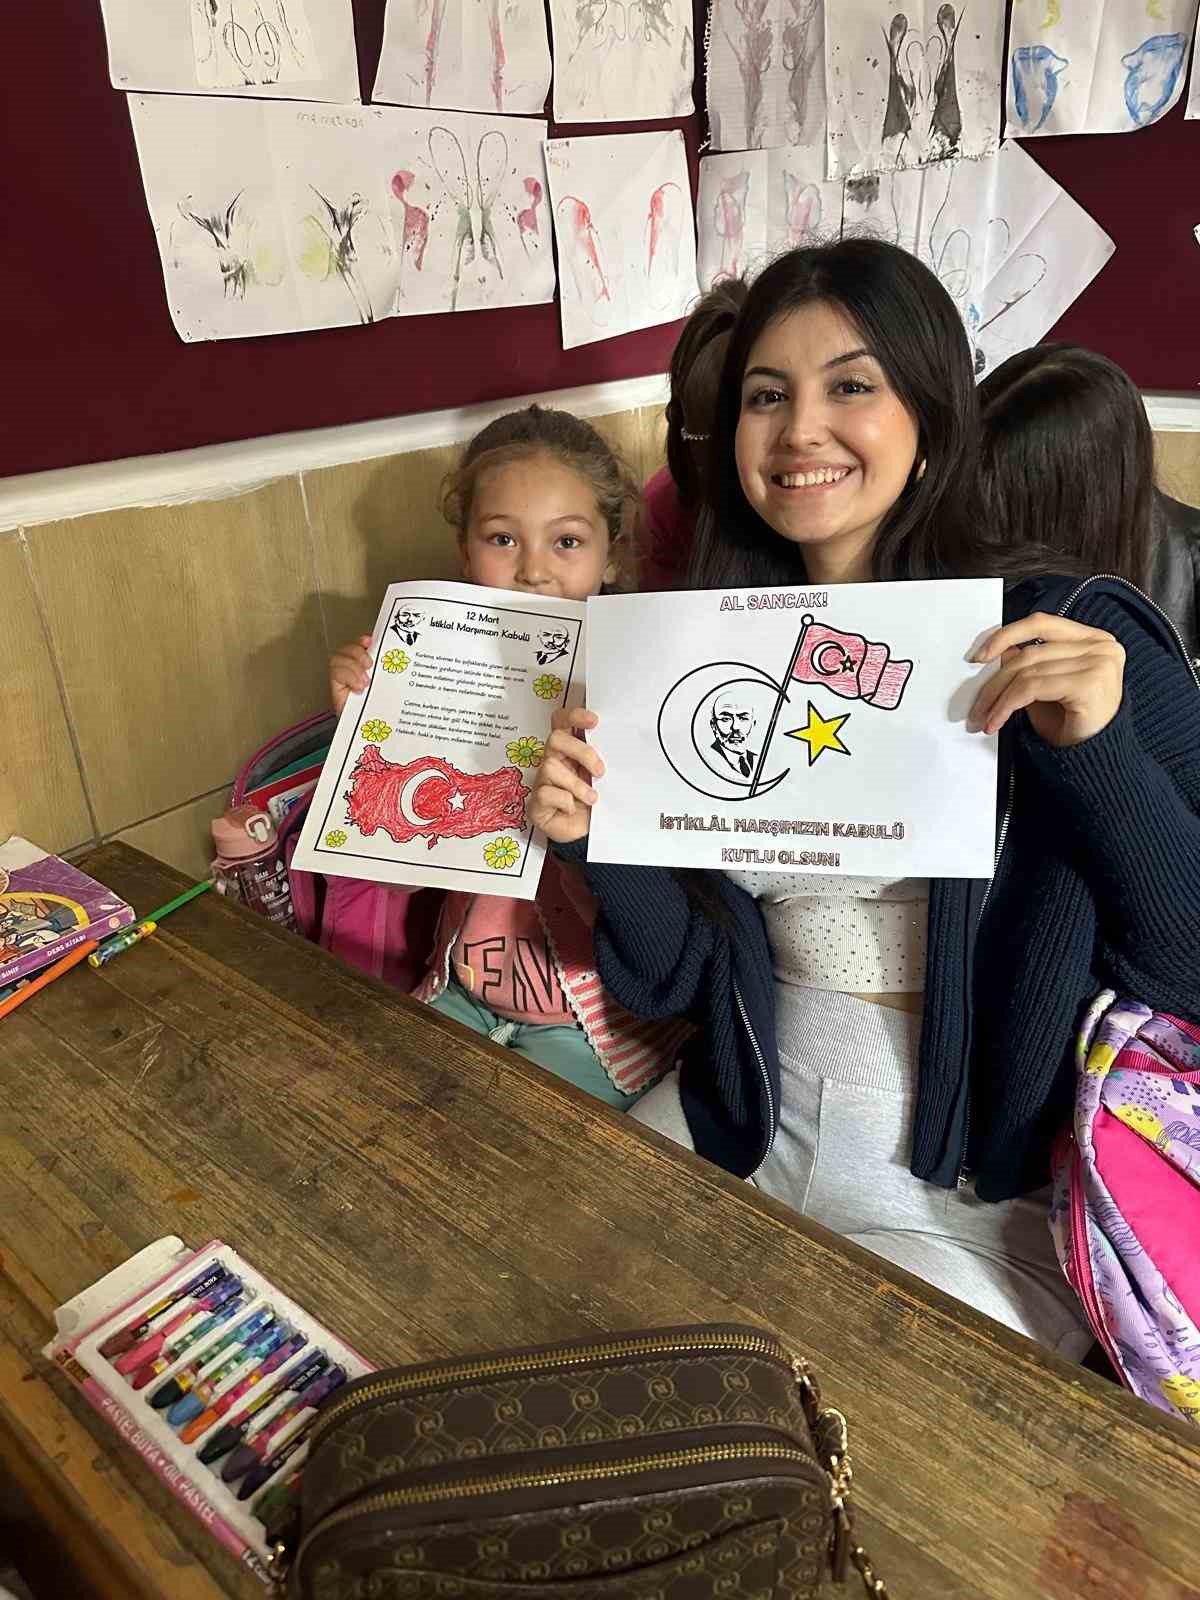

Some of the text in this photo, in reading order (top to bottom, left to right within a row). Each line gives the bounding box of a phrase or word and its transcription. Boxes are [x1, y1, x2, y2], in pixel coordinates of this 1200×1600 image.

[720, 592, 828, 611] AL SANCAK!
[466, 610, 499, 624] 12 Mart
[456, 622, 499, 637] Marşımızın
[501, 629, 530, 642] Kabulü
[733, 818, 830, 837] MARŞIMIZIN
[832, 822, 904, 840] KABULÜ
[721, 848, 841, 867] KUTLU OLSUN!
[47, 945, 65, 957] DERS
